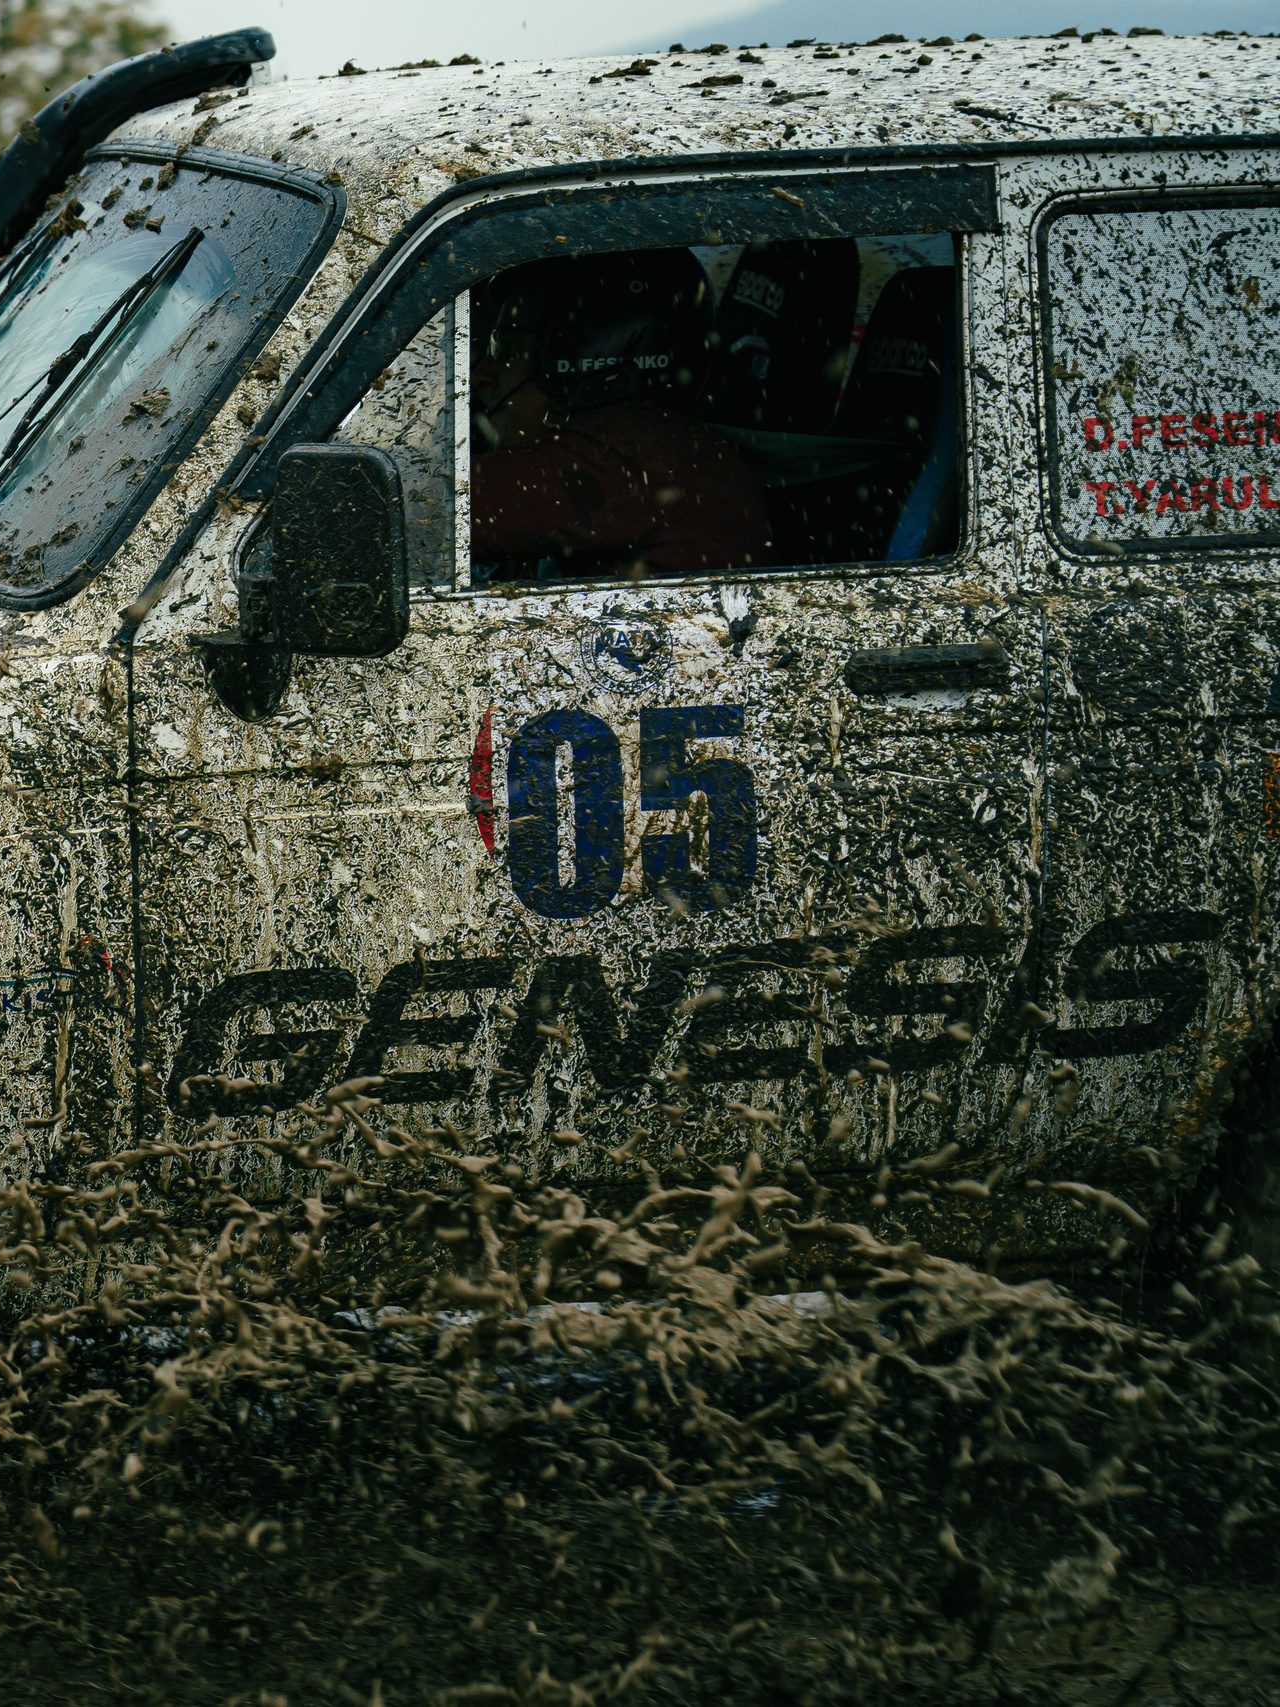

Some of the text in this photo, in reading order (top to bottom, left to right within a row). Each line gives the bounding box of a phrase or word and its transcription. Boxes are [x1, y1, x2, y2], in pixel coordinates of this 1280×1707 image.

[581, 354, 669, 372] FESNKO
[508, 704, 757, 919] 05
[168, 909, 1224, 1117] GENESIS
